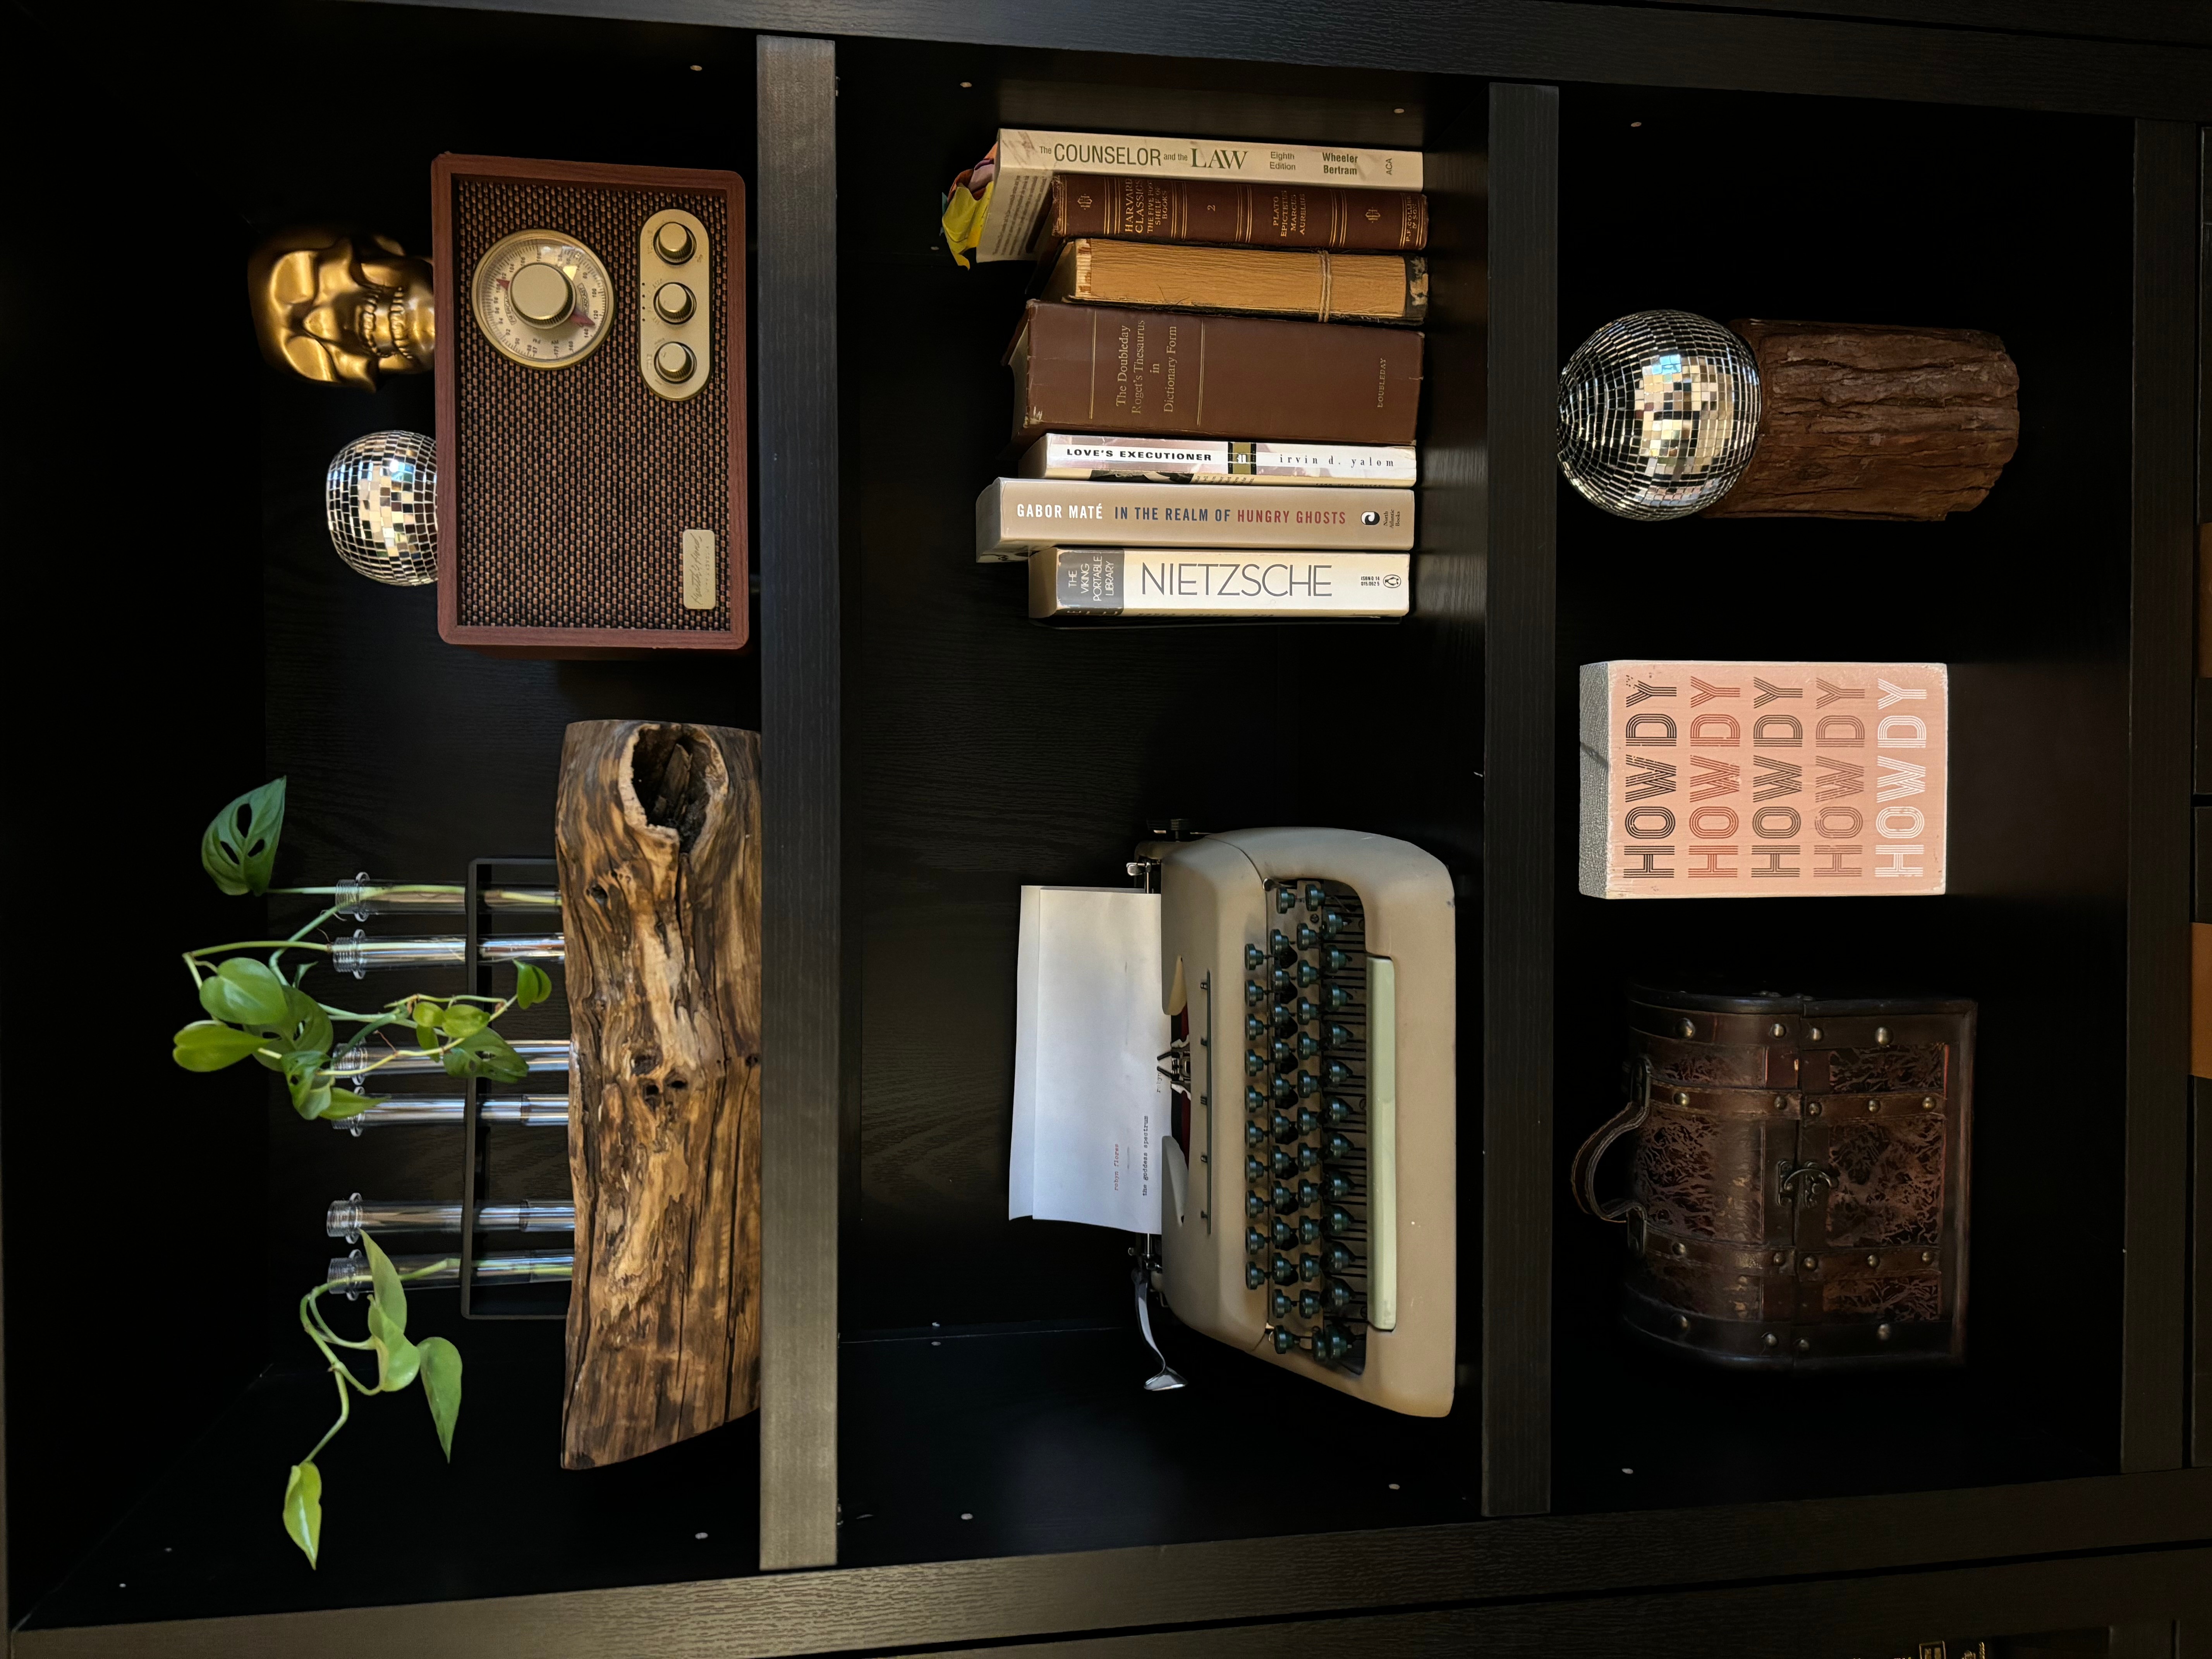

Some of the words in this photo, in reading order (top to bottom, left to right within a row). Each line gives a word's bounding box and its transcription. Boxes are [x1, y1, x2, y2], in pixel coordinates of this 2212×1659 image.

[1039, 146, 1051, 154] The
[1054, 143, 1161, 166] COUNSELOR
[1164, 153, 1176, 161] and
[1190, 148, 1249, 169] LAW
[1269, 161, 1296, 171] Edition
[1270, 151, 1295, 161] Eighth
[1322, 152, 1358, 163] Wheeler
[1323, 165, 1357, 175] Bertram
[1125, 178, 1134, 232] HARVARD
[1135, 180, 1144, 234] CLASSICS
[1156, 186, 1162, 196] OF
[1118, 325, 1130, 382] Doubleday
[1134, 320, 1145, 373] Thesaurus
[1166, 326, 1176, 354] Form
[1150, 364, 1159, 374] in
[1164, 357, 1177, 412] Dictionary
[1116, 386, 1126, 407] The
[1132, 375, 1144, 414] Roget's
[1067, 448, 1113, 457] LOVE'S
[1120, 451, 1212, 461] EXECUTIONER
[1280, 454, 1318, 465] irvin
[1329, 456, 1341, 465] d.
[1351, 457, 1394, 467] yalom
[1017, 504, 1062, 518] GABOR
[1069, 503, 1103, 519] MATÉ
[1115, 507, 1128, 520] IN
[1135, 507, 1158, 520] THE
[1166, 508, 1208, 522] REALM
[1215, 509, 1231, 522] OF
[1238, 510, 1290, 523] HUNGRY
[1297, 511, 1346, 524] GHOSTS
[1068, 570, 1077, 588] THE
[1081, 563, 1089, 594] VIKING
[1093, 556, 1102, 601] PORTABLE
[1105, 561, 1114, 596] LIBRARY
[1142, 562, 1332, 597] NIETZSCHE
[1623, 674, 1677, 878] HOWDY
[1688, 675, 1740, 878] HOWDY
[1751, 677, 1803, 878] HOWDY
[1814, 677, 1865, 878] HOWDY
[1875, 677, 1927, 878] HOWDY
